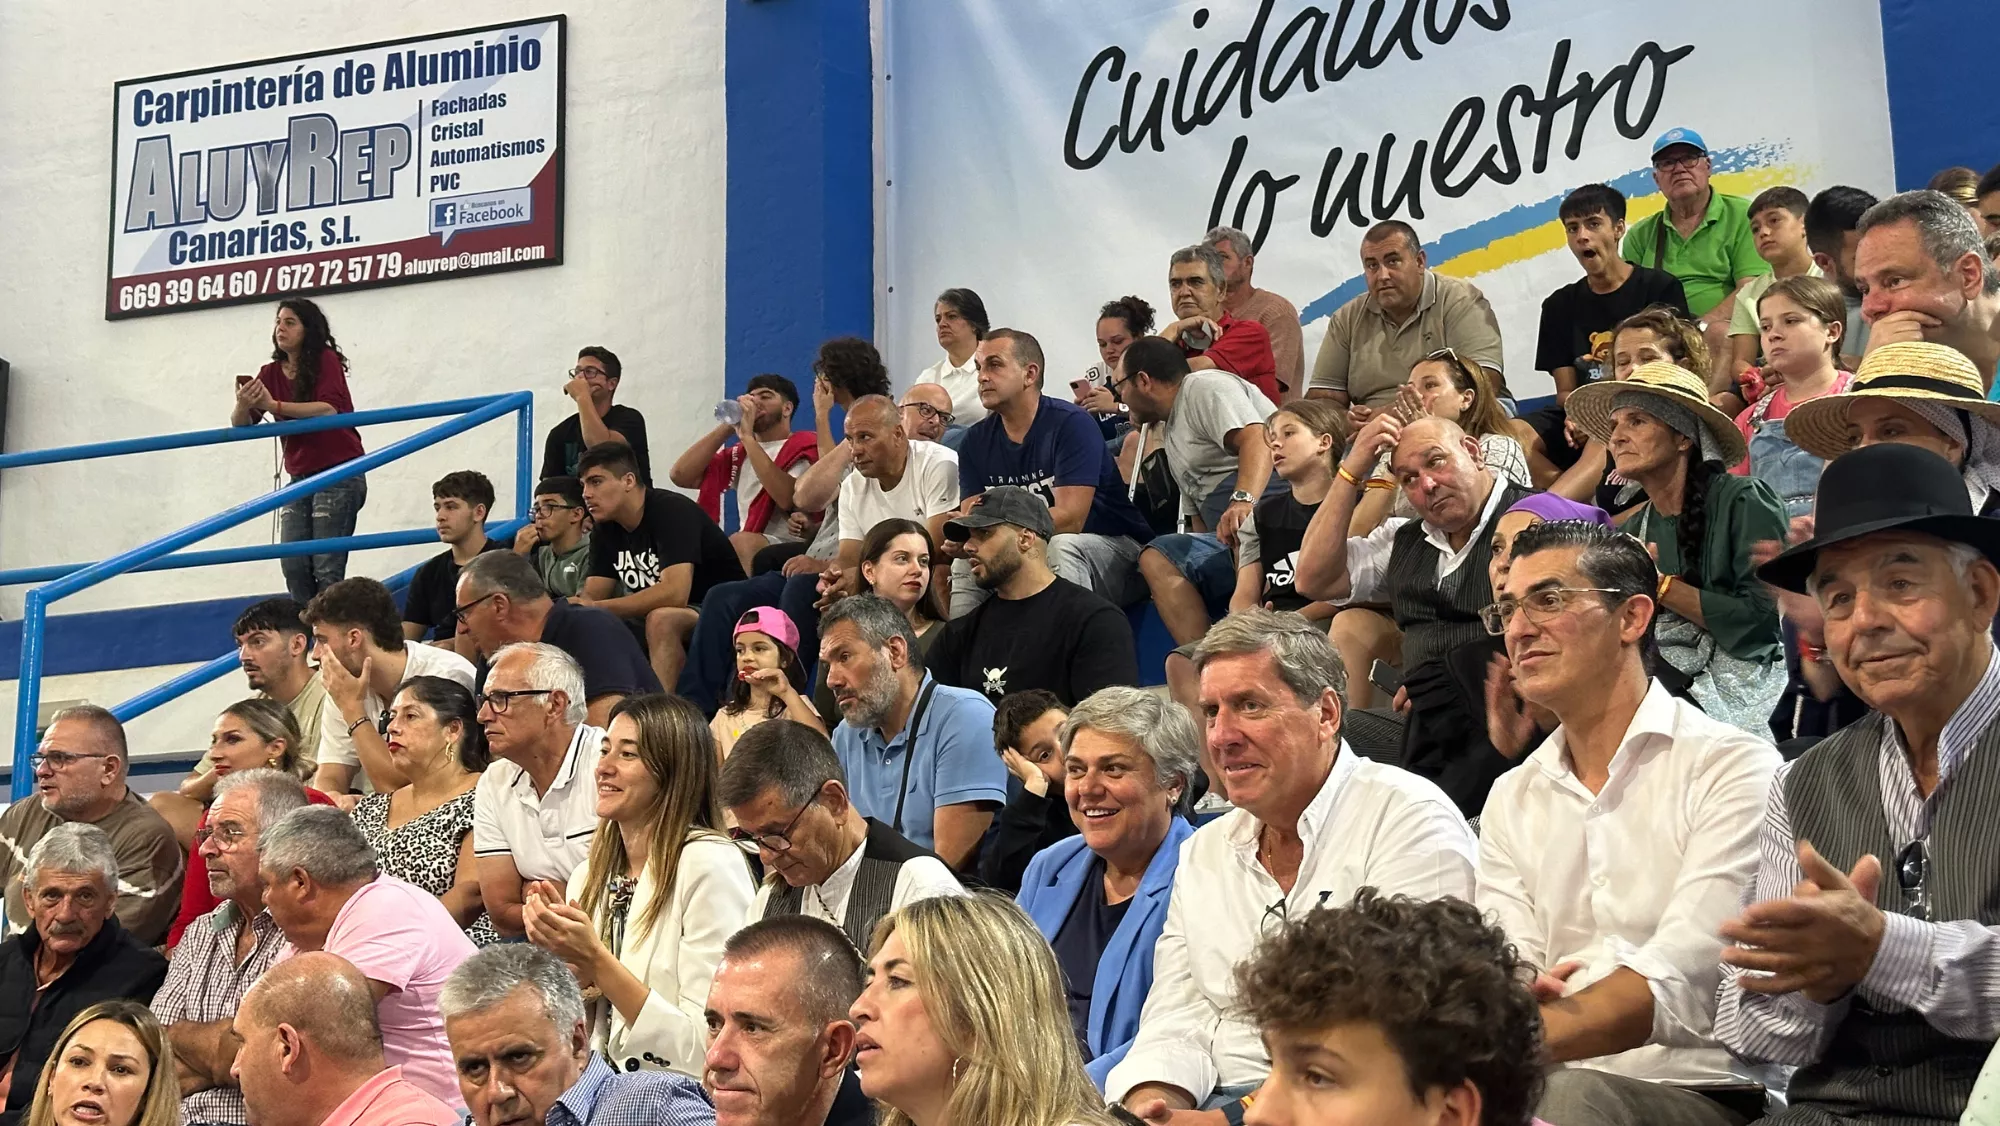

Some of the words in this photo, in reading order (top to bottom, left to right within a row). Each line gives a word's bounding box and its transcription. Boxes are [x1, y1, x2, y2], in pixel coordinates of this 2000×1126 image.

[133, 64, 324, 127] Carpintería
[333, 59, 375, 98] de
[383, 34, 541, 91] Aluminio
[431, 92, 507, 117] Fachadas
[431, 118, 484, 142] Cristal
[430, 138, 545, 168] Automatismos
[1206, 136, 1300, 255] lo
[1310, 38, 1694, 238] nuestro
[430, 172, 460, 193] PVC
[459, 203, 524, 225] Facebook
[168, 219, 312, 265] Canarias,
[320, 215, 361, 246] S.L.
[119, 281, 162, 311] 669
[165, 278, 194, 305] 39
[197, 275, 225, 301] 64
[229, 270, 258, 296] 60
[261, 267, 273, 293] /
[276, 263, 315, 291] 672
[318, 260, 344, 286] 72
[347, 255, 373, 283] 57
[376, 252, 402, 279] 79
[404, 244, 545, 276] aluyrep@gmail.com
